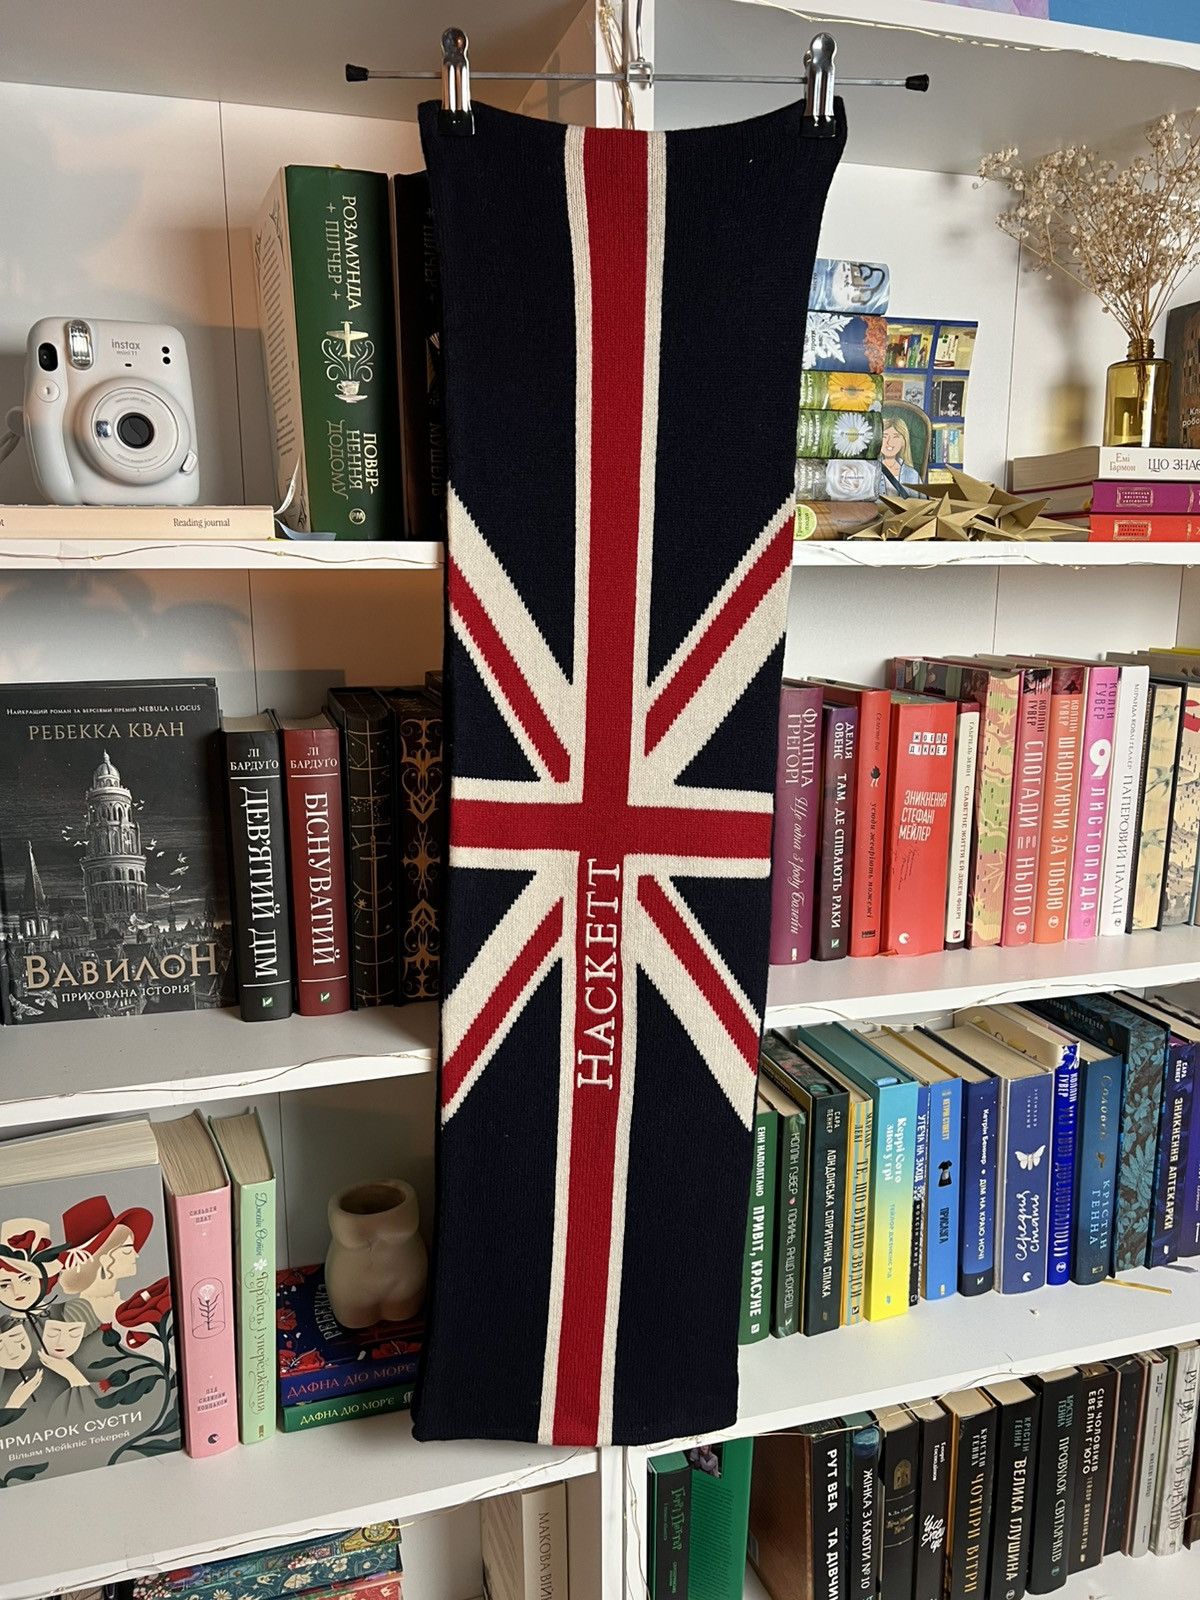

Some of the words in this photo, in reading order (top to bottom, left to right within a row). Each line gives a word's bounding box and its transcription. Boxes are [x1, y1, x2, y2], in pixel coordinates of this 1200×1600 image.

[325, 220, 342, 284] ПІЛЧЕР
[342, 195, 362, 311] РОЗАМУНДА
[111, 339, 141, 350] instax
[326, 419, 349, 500] ДОДОМУ
[345, 430, 363, 491] НЕННЯ
[363, 432, 379, 496] ПОВЕР-
[1148, 458, 1170, 473] ЩО
[173, 517, 203, 529] Reading
[203, 517, 231, 529] journal
[1026, 700, 1038, 727] ГУВЕР
[1037, 698, 1049, 733] КОЛЛІН
[1058, 700, 1070, 726] ГУВЕР
[1068, 699, 1080, 732] КОЛЛІН
[1093, 682, 1107, 720] ГУВЕР
[28, 724, 122, 741] РЕБЕККА
[128, 721, 185, 738] КВАН
[801, 708, 818, 788] ФІЛІППА
[833, 722, 845, 760] ОВЕНС
[845, 722, 854, 760] ДЕЛІЯ
[1090, 738, 1111, 776] 9
[835, 773, 848, 805] ТАМ,
[904, 790, 949, 808] ЗНИКНЕННЯ
[1017, 740, 1044, 828] СПОГАДИ
[1053, 736, 1078, 830] ШКОДУЮЧИ
[788, 793, 808, 820] Ще
[835, 807, 846, 826] ДЕ
[900, 807, 936, 825] СТЕФАНІ
[1116, 775, 1134, 859] ПАПЕРОВИЙ
[792, 822, 805, 850] одна
[898, 824, 932, 842] МЕЙЛЕР
[1017, 836, 1037, 850] ПРО
[1050, 834, 1069, 854] ЗА
[1080, 787, 1106, 911] ЛИСТОПАДА
[787, 860, 806, 890] роду
[832, 828, 845, 892] СПІВАЮТЬ
[304, 793, 341, 967] БІСНУВАТИЙ
[1012, 857, 1035, 916] НЬОГО
[1046, 860, 1068, 910] ТОБОЮ
[1112, 864, 1127, 915] ПАЛАЦ
[789, 891, 807, 934] Болейн
[831, 895, 842, 929] РАКИ
[247, 928, 278, 979] ДІМ
[577, 858, 620, 1091] HACKETT
[62, 988, 138, 1002] ПРИХОВАНА
[142, 985, 190, 997] ІСТОРІЯ
[1057, 1074, 1069, 1098] ГУВЕР
[1174, 1060, 1182, 1083] ПЕННЕР
[1180, 1062, 1188, 1078] САРА
[757, 1126, 766, 1144] ЕНН
[826, 1108, 834, 1133] ПЕННЕР
[833, 1110, 841, 1129] САРА
[894, 1116, 907, 1153] Керрі
[916, 1114, 926, 1143] УТЕЧА
[1170, 1097, 1184, 1162] ЗНИКНЕННЯ
[916, 1143, 925, 1157] НА
[755, 1144, 766, 1197] НАПОЛІТАНО
[824, 1149, 837, 1207] ЛОНДОНСЬКА
[854, 1158, 868, 1179] ТЕ,
[882, 1162, 893, 1182] грі
[894, 1153, 906, 1183] Сото
[914, 1158, 924, 1183] ЗАХІД
[853, 1182, 868, 1202] ЩО
[978, 1178, 987, 1196] ДІМ
[979, 1197, 987, 1211] НА
[1163, 1165, 1179, 1230] АПТЕКАРКИ
[750, 1205, 765, 1256] ПРИВІТ,
[850, 1207, 866, 1249] ВИДНО
[938, 1207, 950, 1244] ПРИСЛУГА
[978, 1211, 986, 1236] КРАЮ
[1015, 1190, 1032, 1261] Середня
[1029, 1194, 1041, 1252] стать
[1089, 1189, 1101, 1245] ГЕННА
[1099, 1179, 1111, 1250] КРІСТІН
[823, 1209, 835, 1264] СПІРИТИЧНА
[977, 1238, 985, 1260] НОЧІ
[749, 1260, 763, 1317] КРАСУНЕ
[821, 1265, 833, 1298] СПІЛКА
[848, 1252, 864, 1299] ЗВІДСИ
[287, 1378, 340, 1399] ДАФНА
[343, 1371, 369, 1389] ДЮ
[1096, 1388, 1105, 1408] СІМ
[1184, 1369, 1198, 1394] РУТ
[84, 1411, 143, 1432] СУЄТИ
[300, 1410, 339, 1426] ДАФНА
[341, 1404, 360, 1418] ДЮ
[1085, 1390, 1097, 1433] ЕВЕЛІН
[970, 1434, 981, 1467] ГЕННА
[978, 1428, 988, 1467] КРІСТІН
[1013, 1419, 1023, 1448] ГЕННА
[1022, 1416, 1032, 1452] КРІСТІН
[1090, 1411, 1103, 1472] ЧОЛОВІКІВ
[8, 1449, 43, 1462] Вільям
[827, 1448, 838, 1478] РУТ
[1056, 1436, 1070, 1495] ПРОВУЛОК
[827, 1481, 838, 1513] ВЕА
[861, 1469, 873, 1509] ЖІНКА
[1010, 1456, 1028, 1514] ВЕЛИКА
[967, 1472, 985, 1539] ЧОТИРИ
[538, 1512, 553, 1572] МАКОВА
[827, 1528, 838, 1549] ТА
[861, 1520, 873, 1560] КАЮТИ
[1051, 1498, 1066, 1562] СВІТЛЯЧКІВ
[1005, 1517, 1023, 1581] ГЛУШИНА
[860, 1577, 871, 1589] 10
[963, 1544, 980, 1593] ВІТРИ
